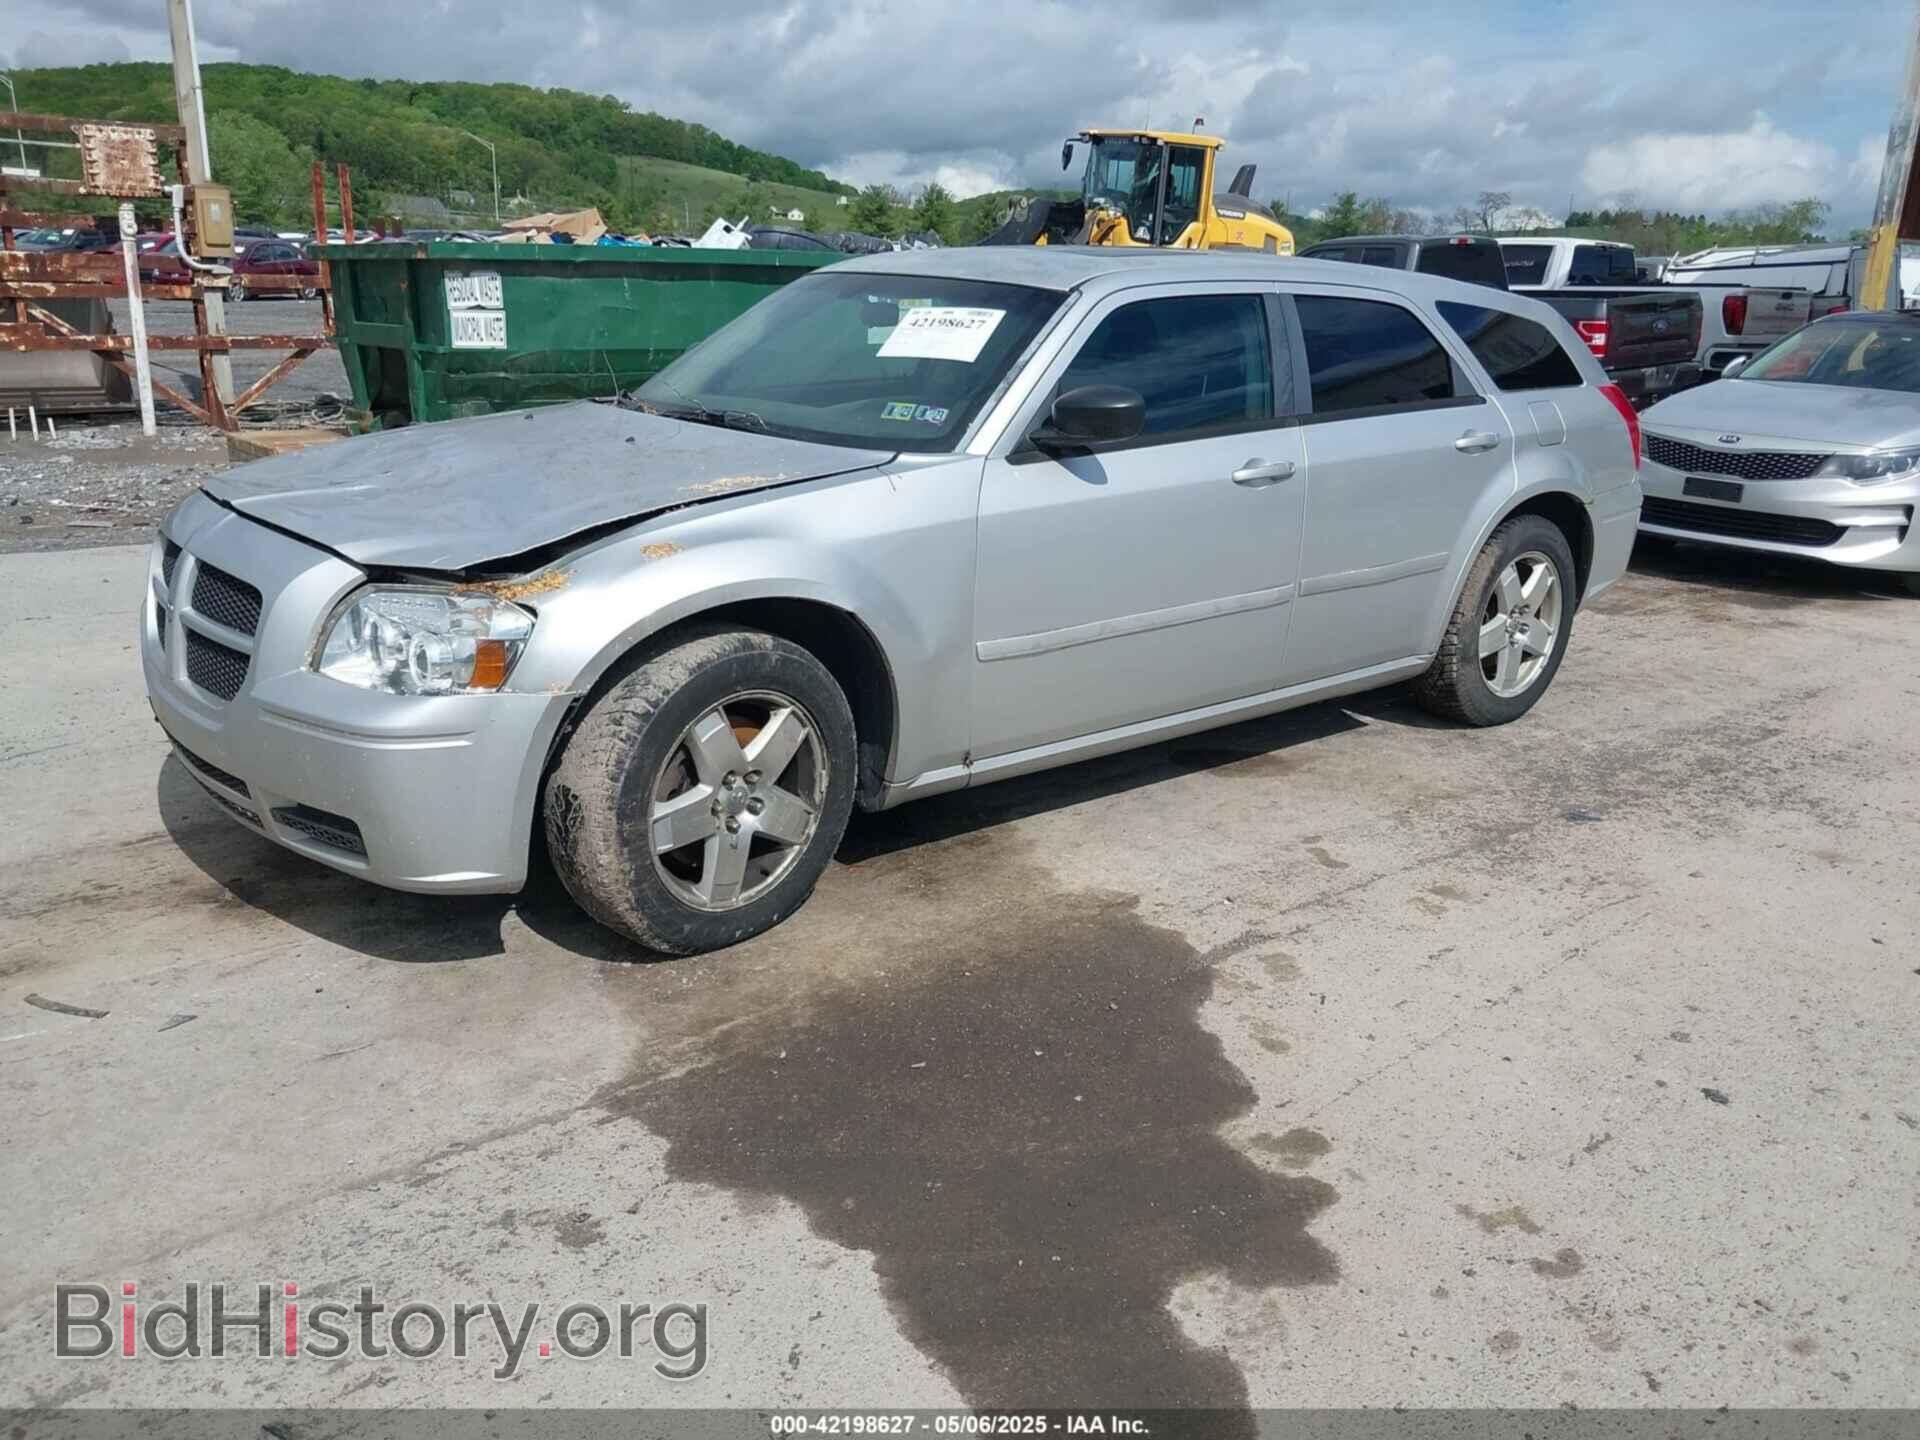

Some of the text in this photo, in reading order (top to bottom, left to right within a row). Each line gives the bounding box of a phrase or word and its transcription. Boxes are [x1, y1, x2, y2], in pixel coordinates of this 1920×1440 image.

[480, 275, 500, 302] WASTE
[484, 317, 503, 342] WASTE
[909, 317, 987, 329] 42198627
